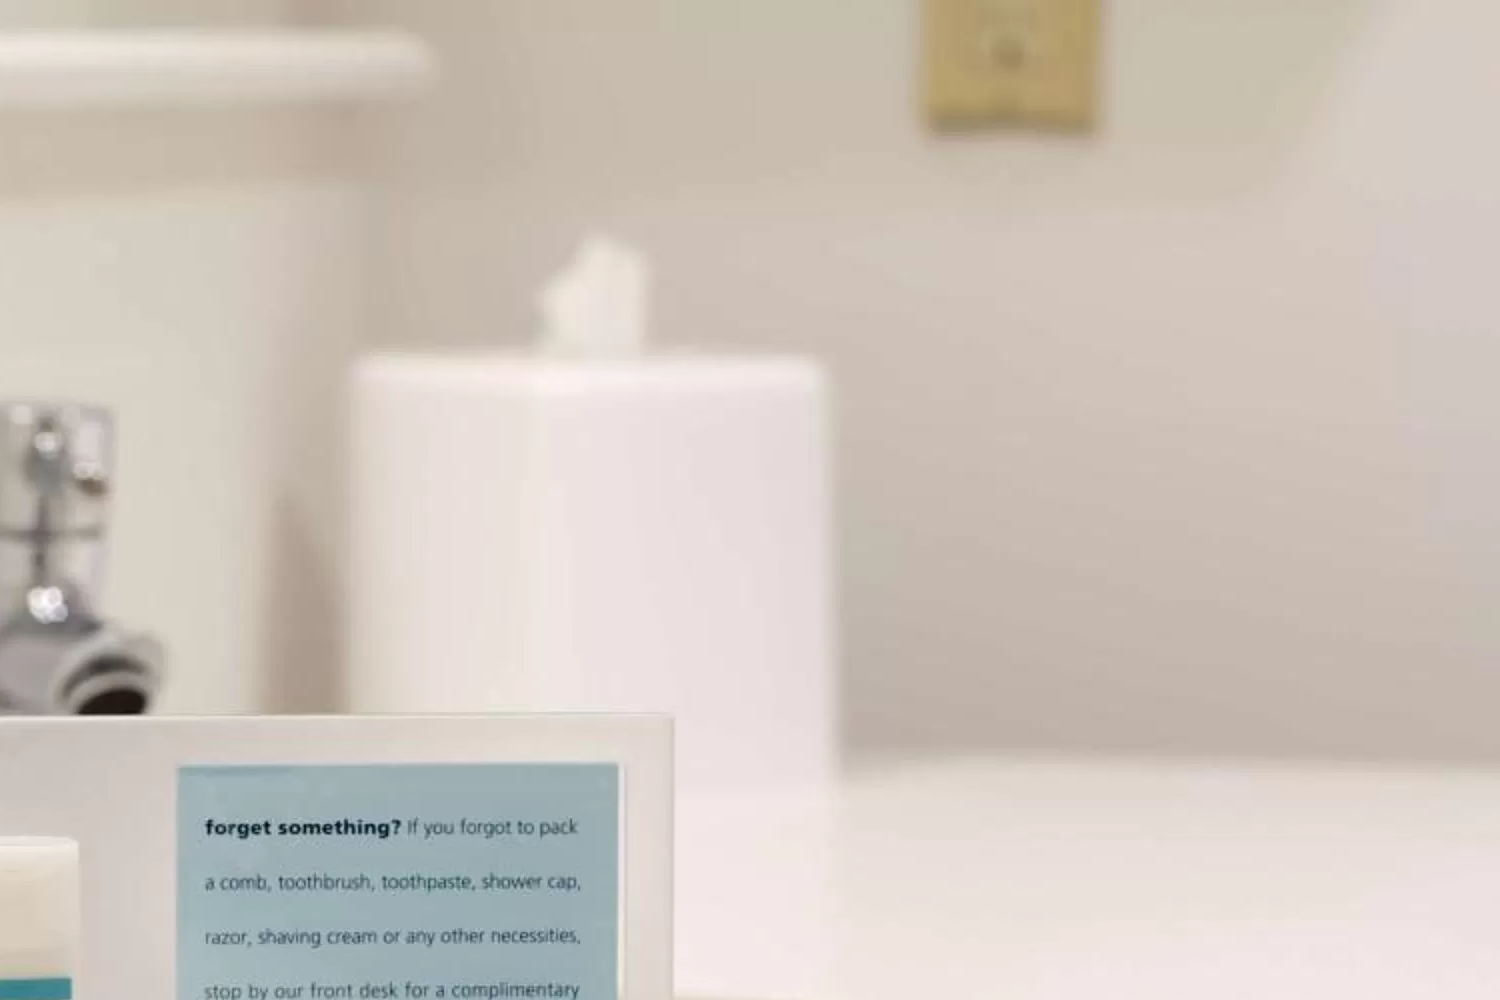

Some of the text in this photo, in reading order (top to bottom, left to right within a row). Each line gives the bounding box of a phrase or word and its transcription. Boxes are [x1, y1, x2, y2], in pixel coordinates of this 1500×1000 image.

[205, 819, 578, 839] forget something? If you forgot to pack
[205, 873, 581, 893] a comb, toothbrush, toothpaste, shower cap,
[205, 927, 581, 948] razor, shaving cream or any other necessities,
[274, 984, 303, 999] our
[310, 983, 353, 999] front
[359, 982, 398, 998] desk
[405, 982, 429, 998] for
[436, 985, 445, 998] a
[451, 981, 580, 1000] complimentary
